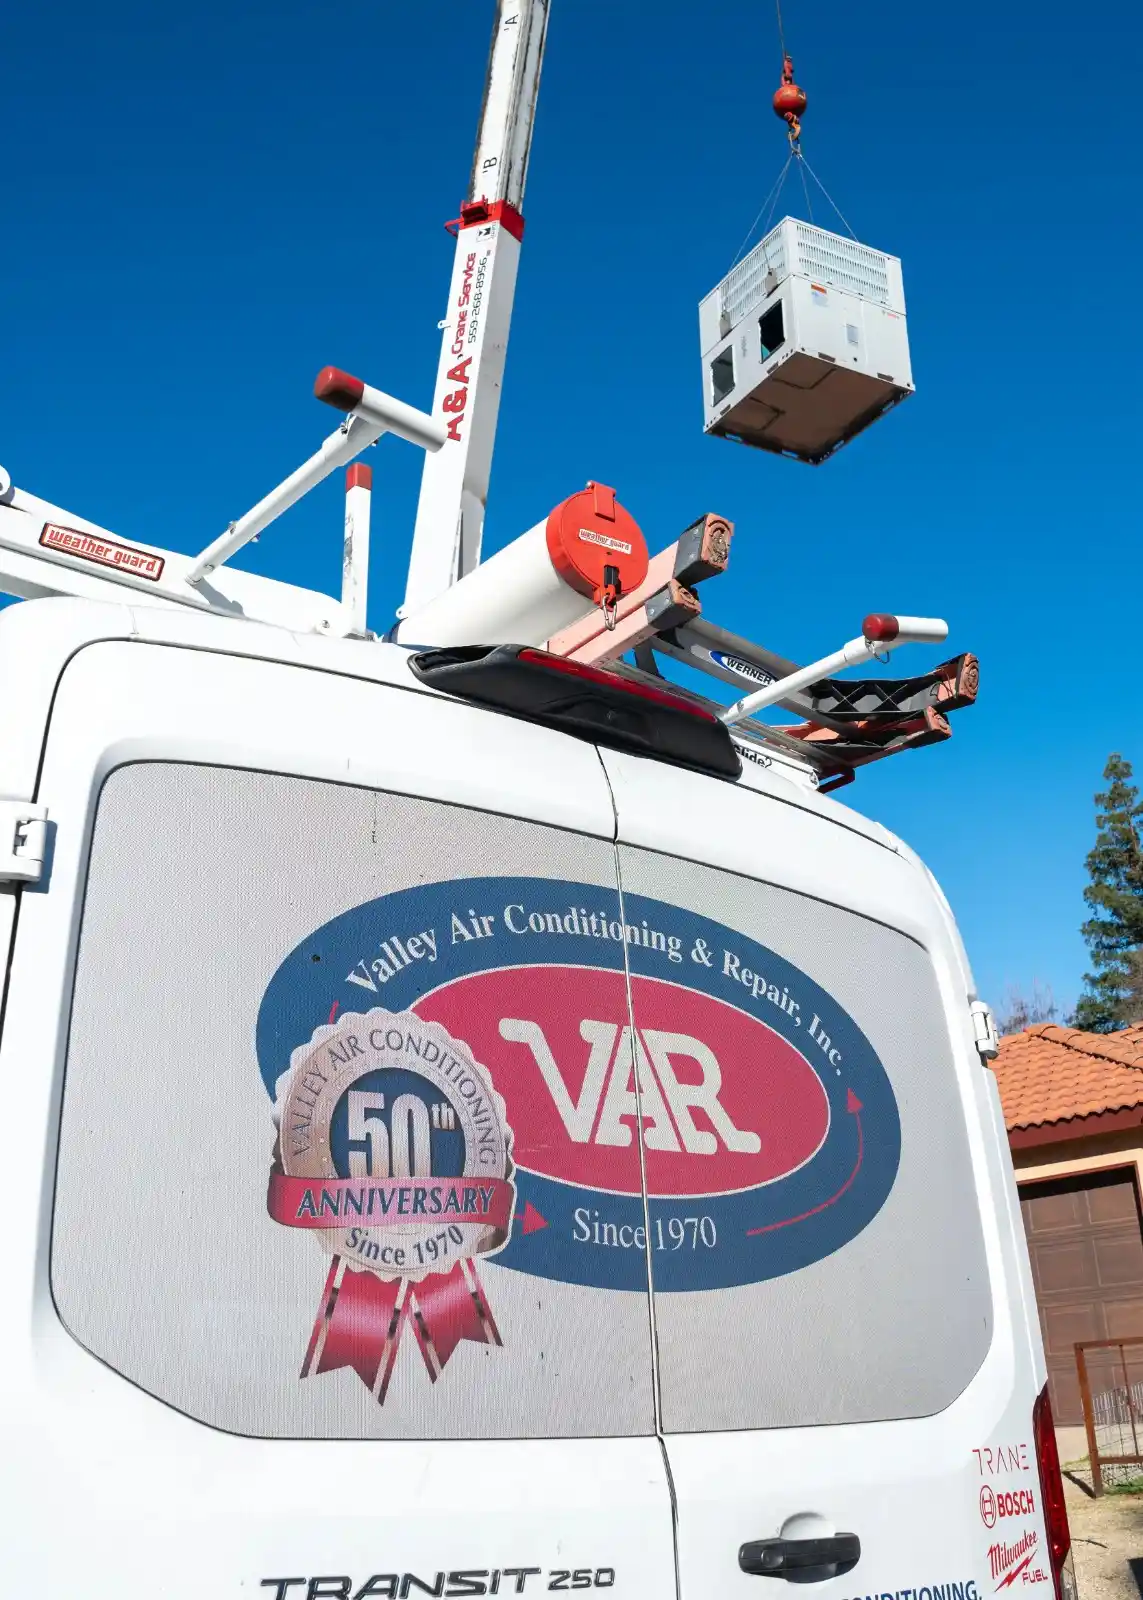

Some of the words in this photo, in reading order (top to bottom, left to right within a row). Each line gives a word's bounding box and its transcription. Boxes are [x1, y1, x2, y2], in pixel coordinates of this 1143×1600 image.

[458, 253, 476, 307] Service
[468, 257, 488, 343] 559-268-8956
[451, 310, 468, 354] Crane
[47, 529, 112, 557] weather
[114, 550, 157, 572] guard
[726, 657, 772, 685] WERNER
[345, 928, 438, 993] Valley
[451, 908, 495, 944] Air
[503, 904, 682, 964] Conditioning
[690, 937, 713, 968] &
[722, 949, 802, 1027] Repair,
[806, 1012, 843, 1076] Inc.
[291, 1063, 329, 1157] VALLEY
[328, 1034, 366, 1071] AIR
[368, 1028, 497, 1166] CONDITIONING
[499, 1017, 761, 1155] VAR
[296, 1185, 497, 1218] ANNIVERSARY
[345, 1226, 406, 1266] Since
[412, 1224, 465, 1265] 1970
[572, 1207, 646, 1248] Since
[655, 1215, 718, 1251] 1970
[972, 1443, 1030, 1476] TRANE
[996, 1488, 1035, 1518] BOSCH
[987, 1529, 1038, 1580] Milwaukee
[260, 1567, 541, 1600] TRANSIT
[547, 1567, 616, 1591] 250
[1021, 1568, 1049, 1586] FUEL
